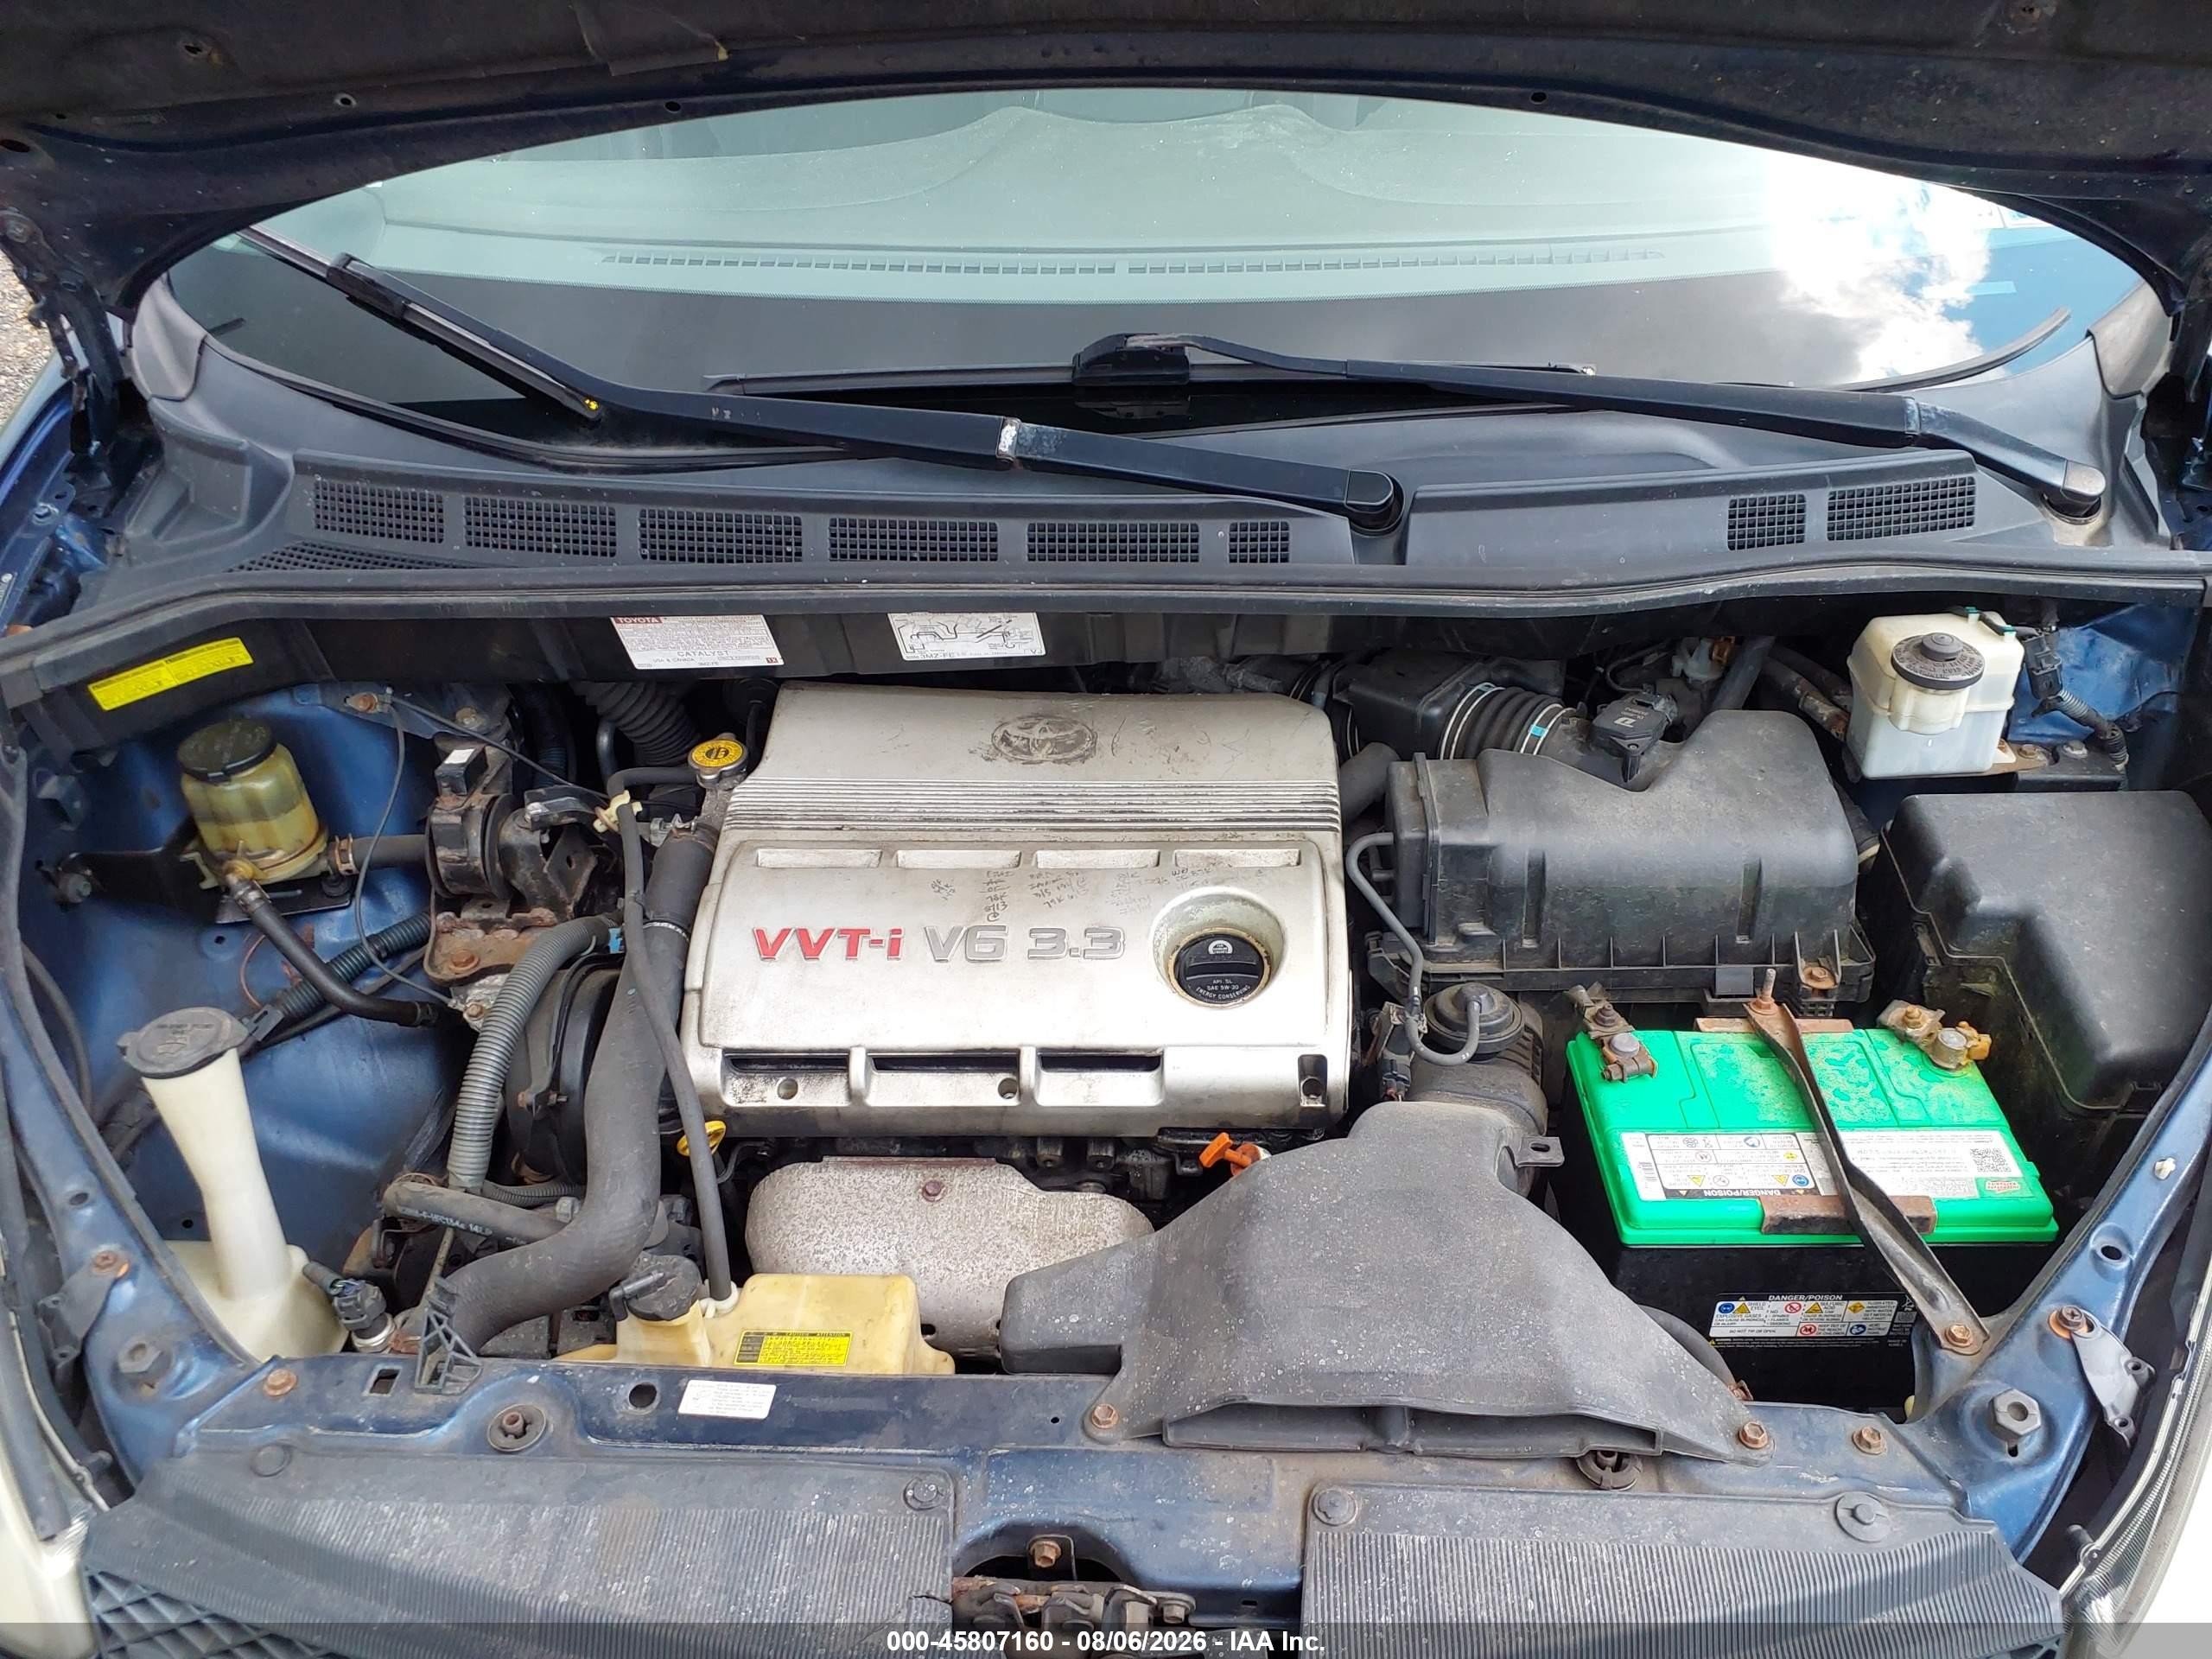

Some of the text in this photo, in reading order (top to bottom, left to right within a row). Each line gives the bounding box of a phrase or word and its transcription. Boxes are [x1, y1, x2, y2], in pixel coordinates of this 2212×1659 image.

[753, 925, 1127, 962] VVT-i V6 3.3
[1196, 984, 1251, 1000] ENERGY CONSERVING
[1703, 1188, 1782, 1198] DANGER/POISON
